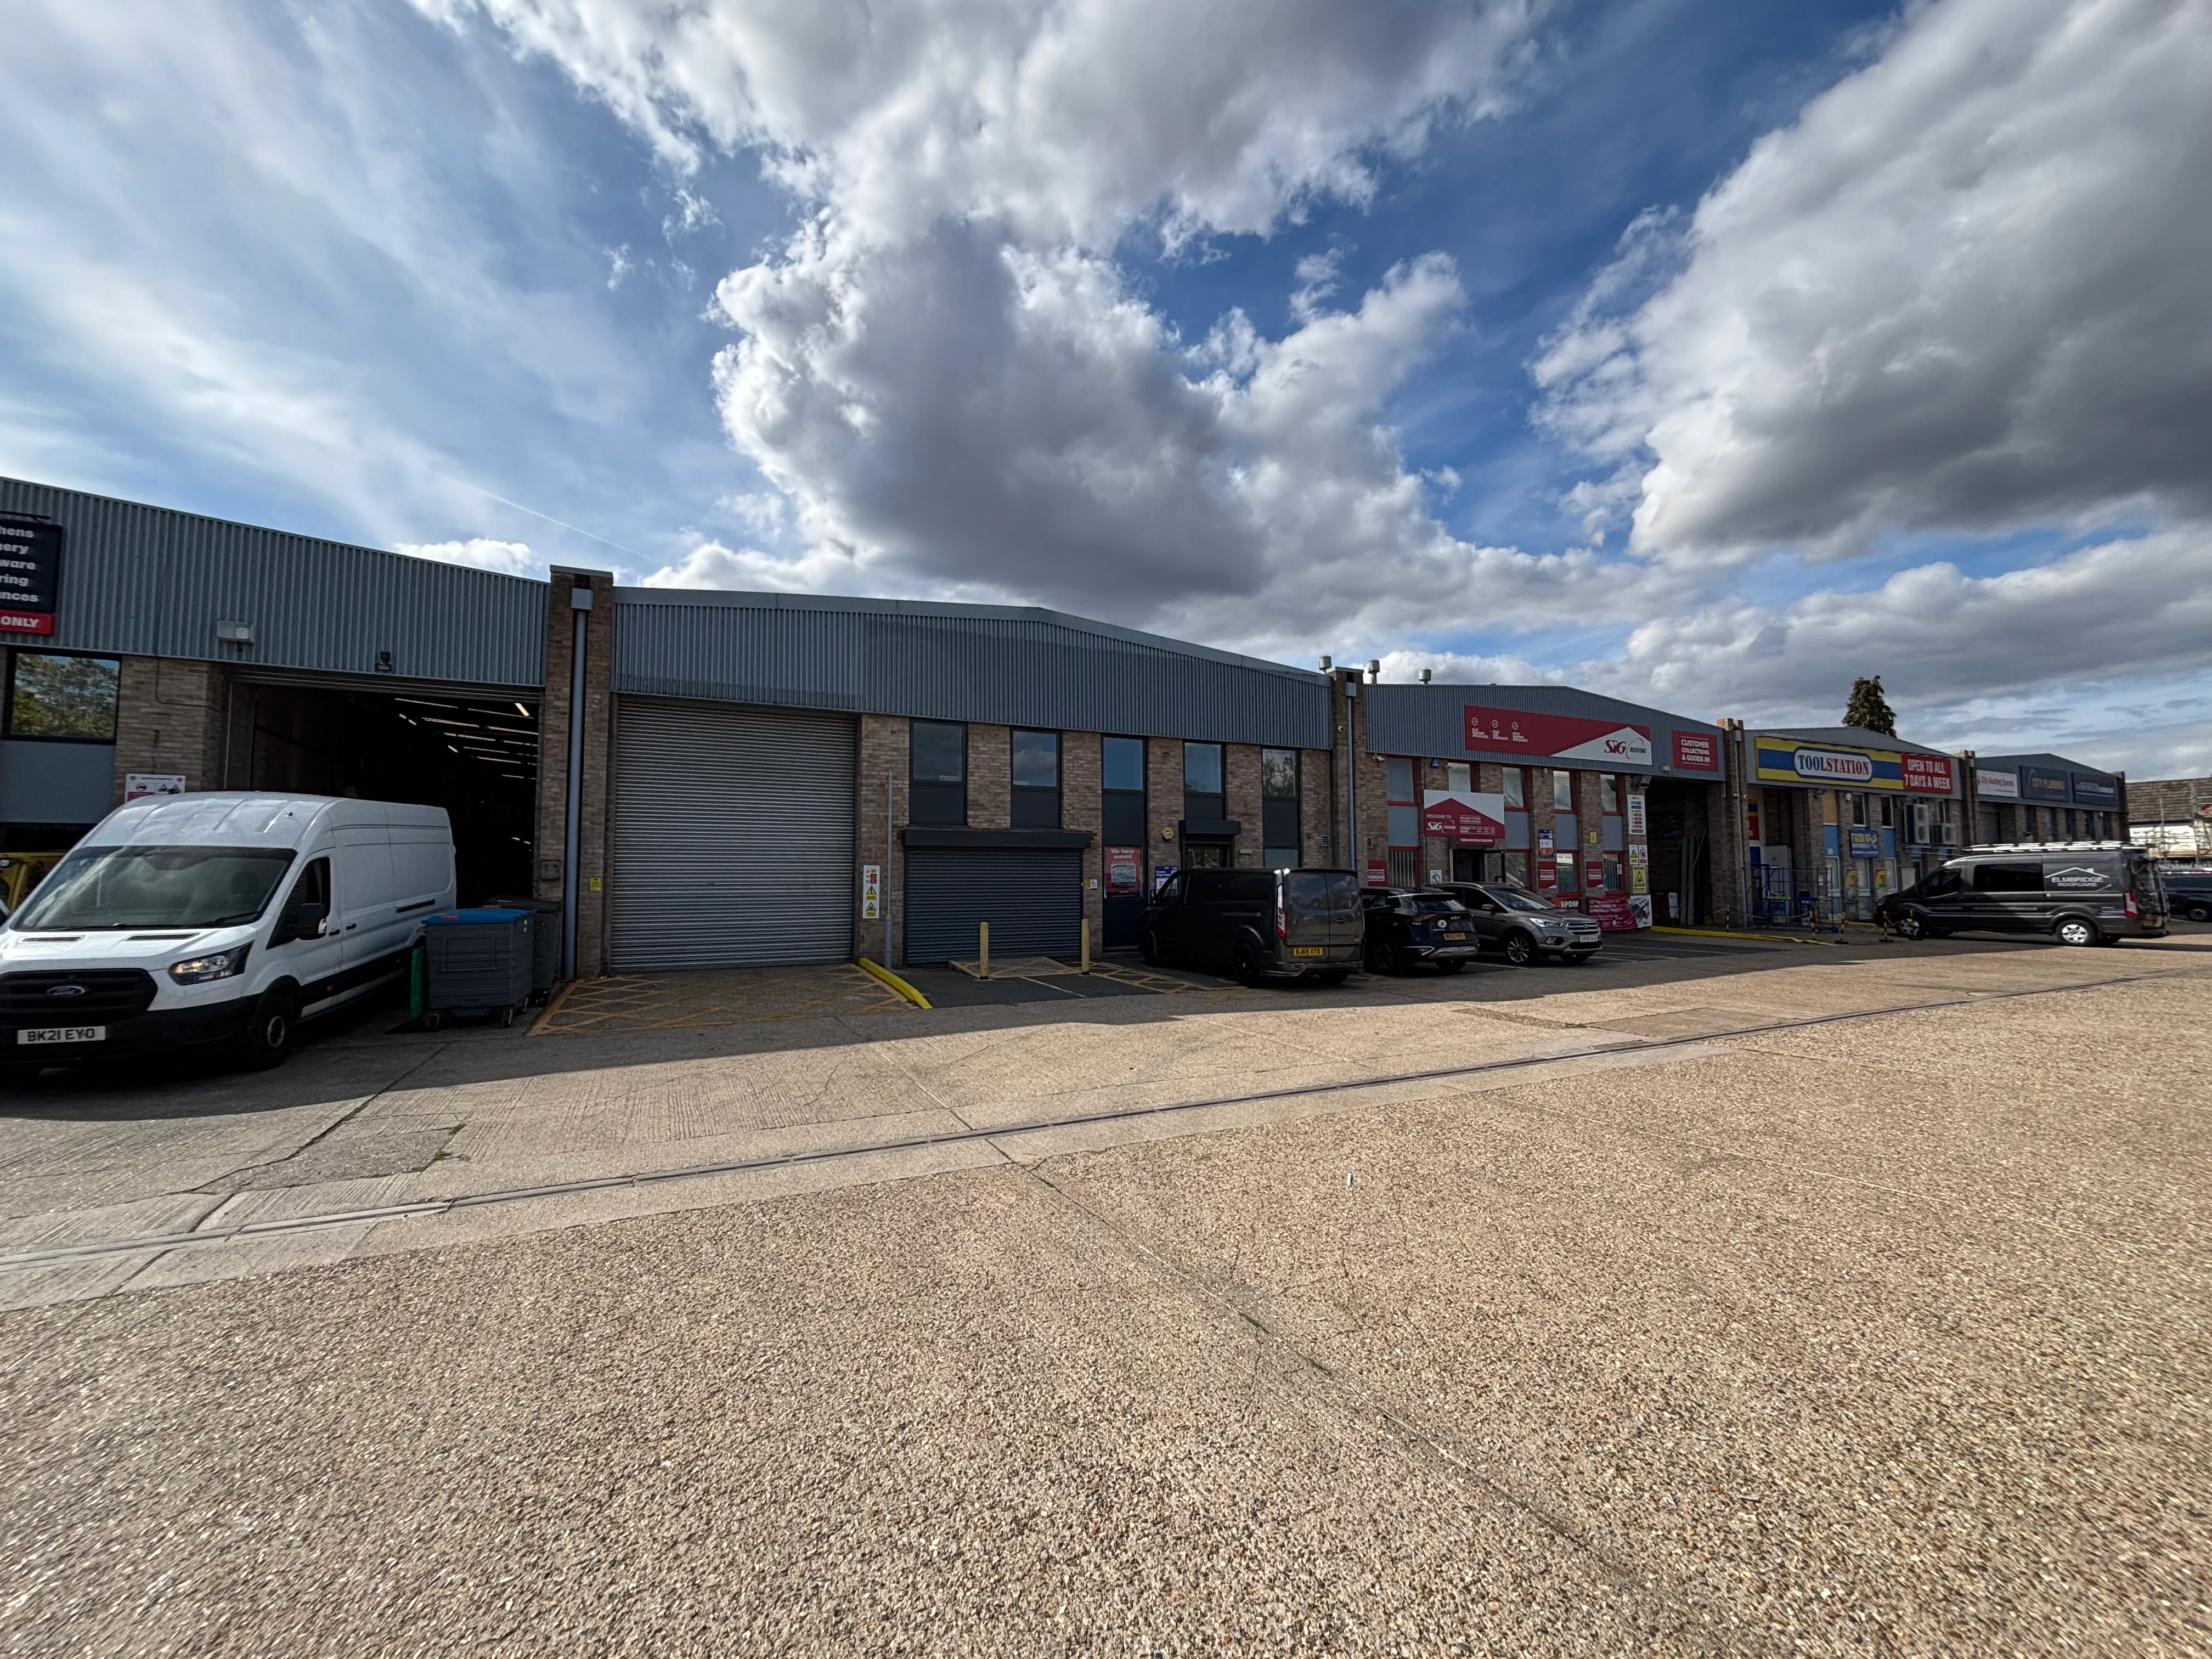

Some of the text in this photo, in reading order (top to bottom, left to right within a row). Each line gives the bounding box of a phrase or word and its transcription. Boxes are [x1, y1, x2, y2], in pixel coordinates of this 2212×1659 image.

[0, 591, 39, 602] nces
[1, 616, 40, 627] ONLY
[1681, 739, 1709, 749] CUSTOMER
[1681, 747, 1710, 755] COLLECTIONS
[1686, 754, 1704, 763] GOODS
[1798, 754, 1869, 775] TOOLSTATION
[1908, 758, 1946, 774] OPEN TO ALL
[1903, 774, 1951, 789] 7 DAYS A WEEK
[27, 1028, 95, 1042] BK21 EYO
